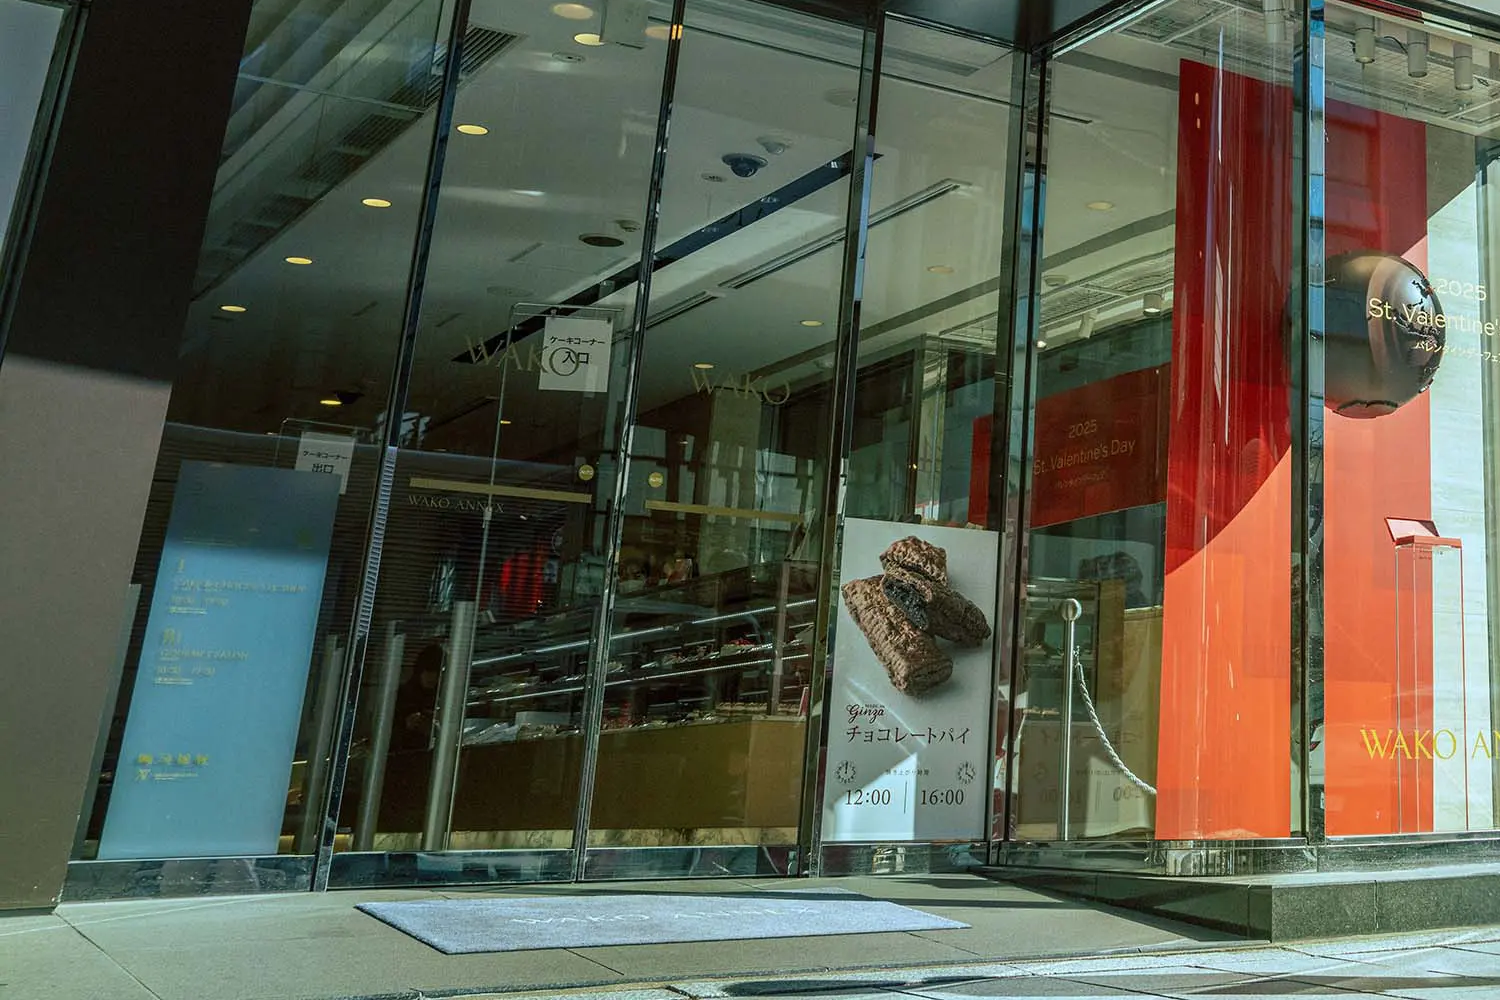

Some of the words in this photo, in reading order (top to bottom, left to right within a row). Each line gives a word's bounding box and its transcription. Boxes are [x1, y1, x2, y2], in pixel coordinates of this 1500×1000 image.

[1437, 278, 1487, 301] 2025
[1369, 297, 1397, 321] St.
[550, 335, 606, 346] ケーキコーナー
[465, 334, 579, 376] WAKO
[562, 351, 590, 364] 入口
[689, 366, 790, 405] WAKO
[1068, 419, 1097, 439] 2025
[1050, 442, 1109, 470] Valentine's
[1111, 439, 1136, 457] Day
[408, 495, 450, 508] WAKO
[846, 704, 885, 724] Ginza
[846, 725, 970, 744] チョコレートパイ
[1360, 729, 1457, 760] WAKO
[845, 789, 891, 805] 12:00
[921, 789, 964, 805] 16:00
